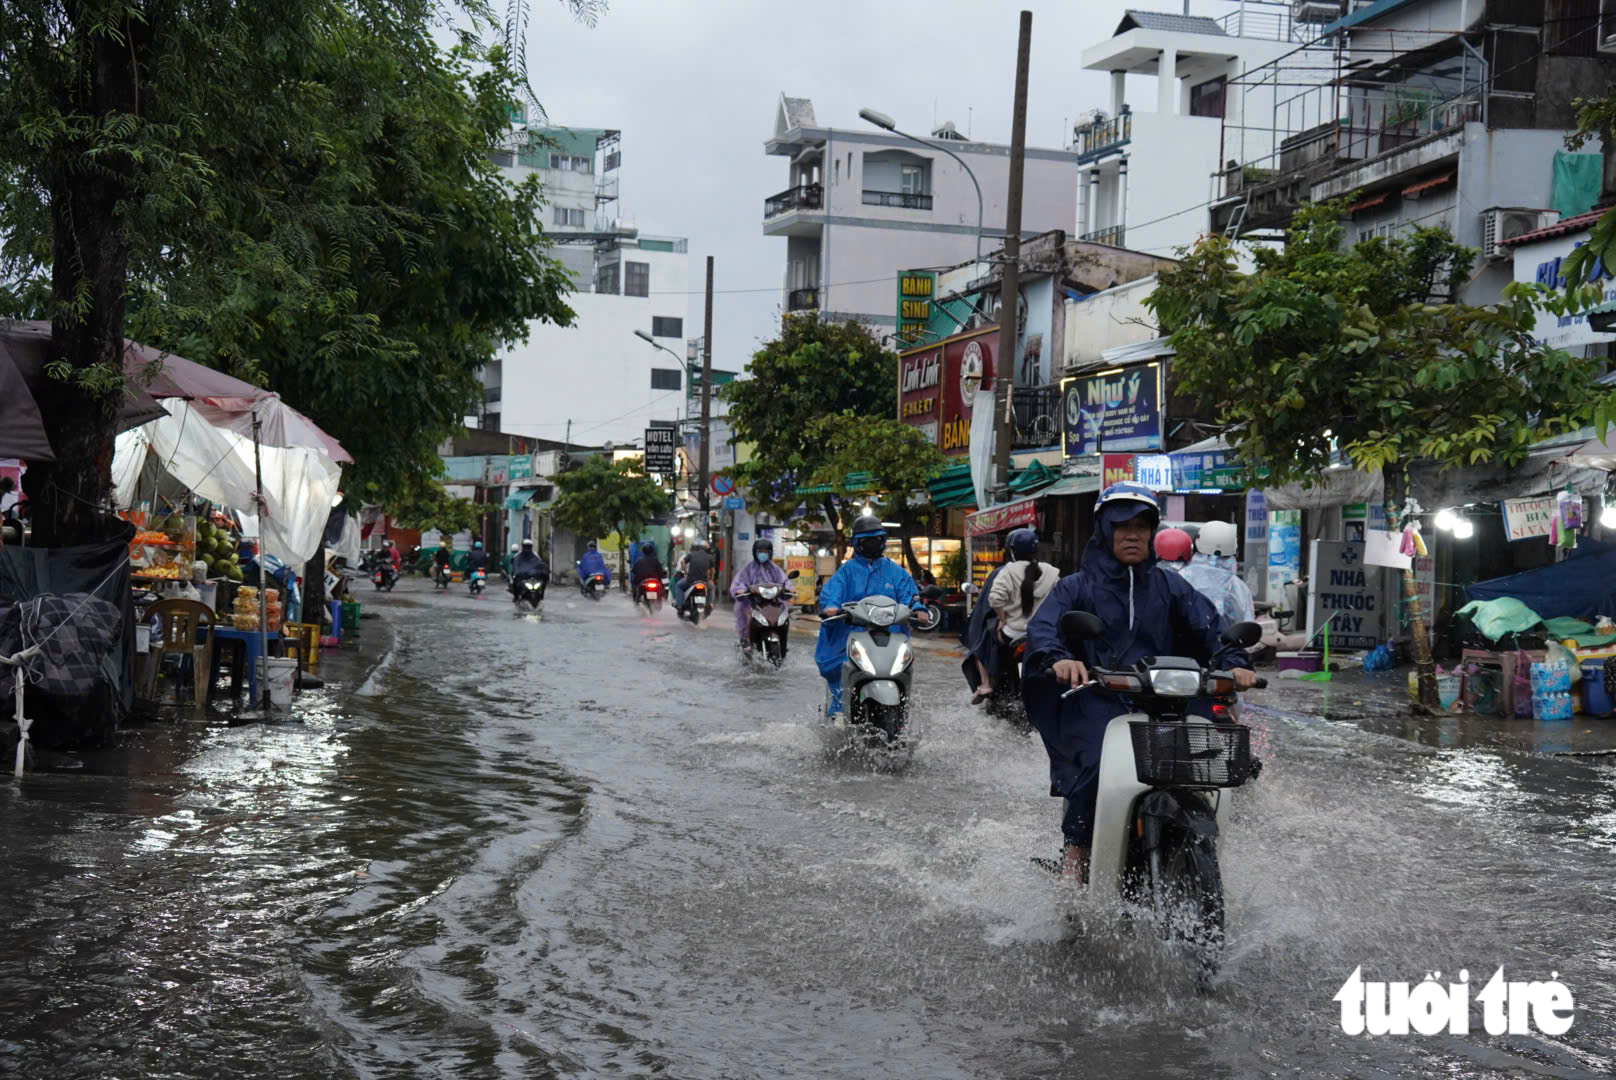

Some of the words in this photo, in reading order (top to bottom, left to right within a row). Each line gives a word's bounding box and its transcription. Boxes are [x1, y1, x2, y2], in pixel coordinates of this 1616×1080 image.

[1087, 377, 1126, 407] Như
[647, 431, 672, 443] HOTEL
[944, 413, 969, 450] BÁN
[1068, 431, 1080, 445] Spa
[1526, 512, 1549, 522] BIA
[1330, 568, 1366, 588] NHÀ
[1320, 589, 1376, 611] THUỐC
[1332, 613, 1364, 633] TÂY
